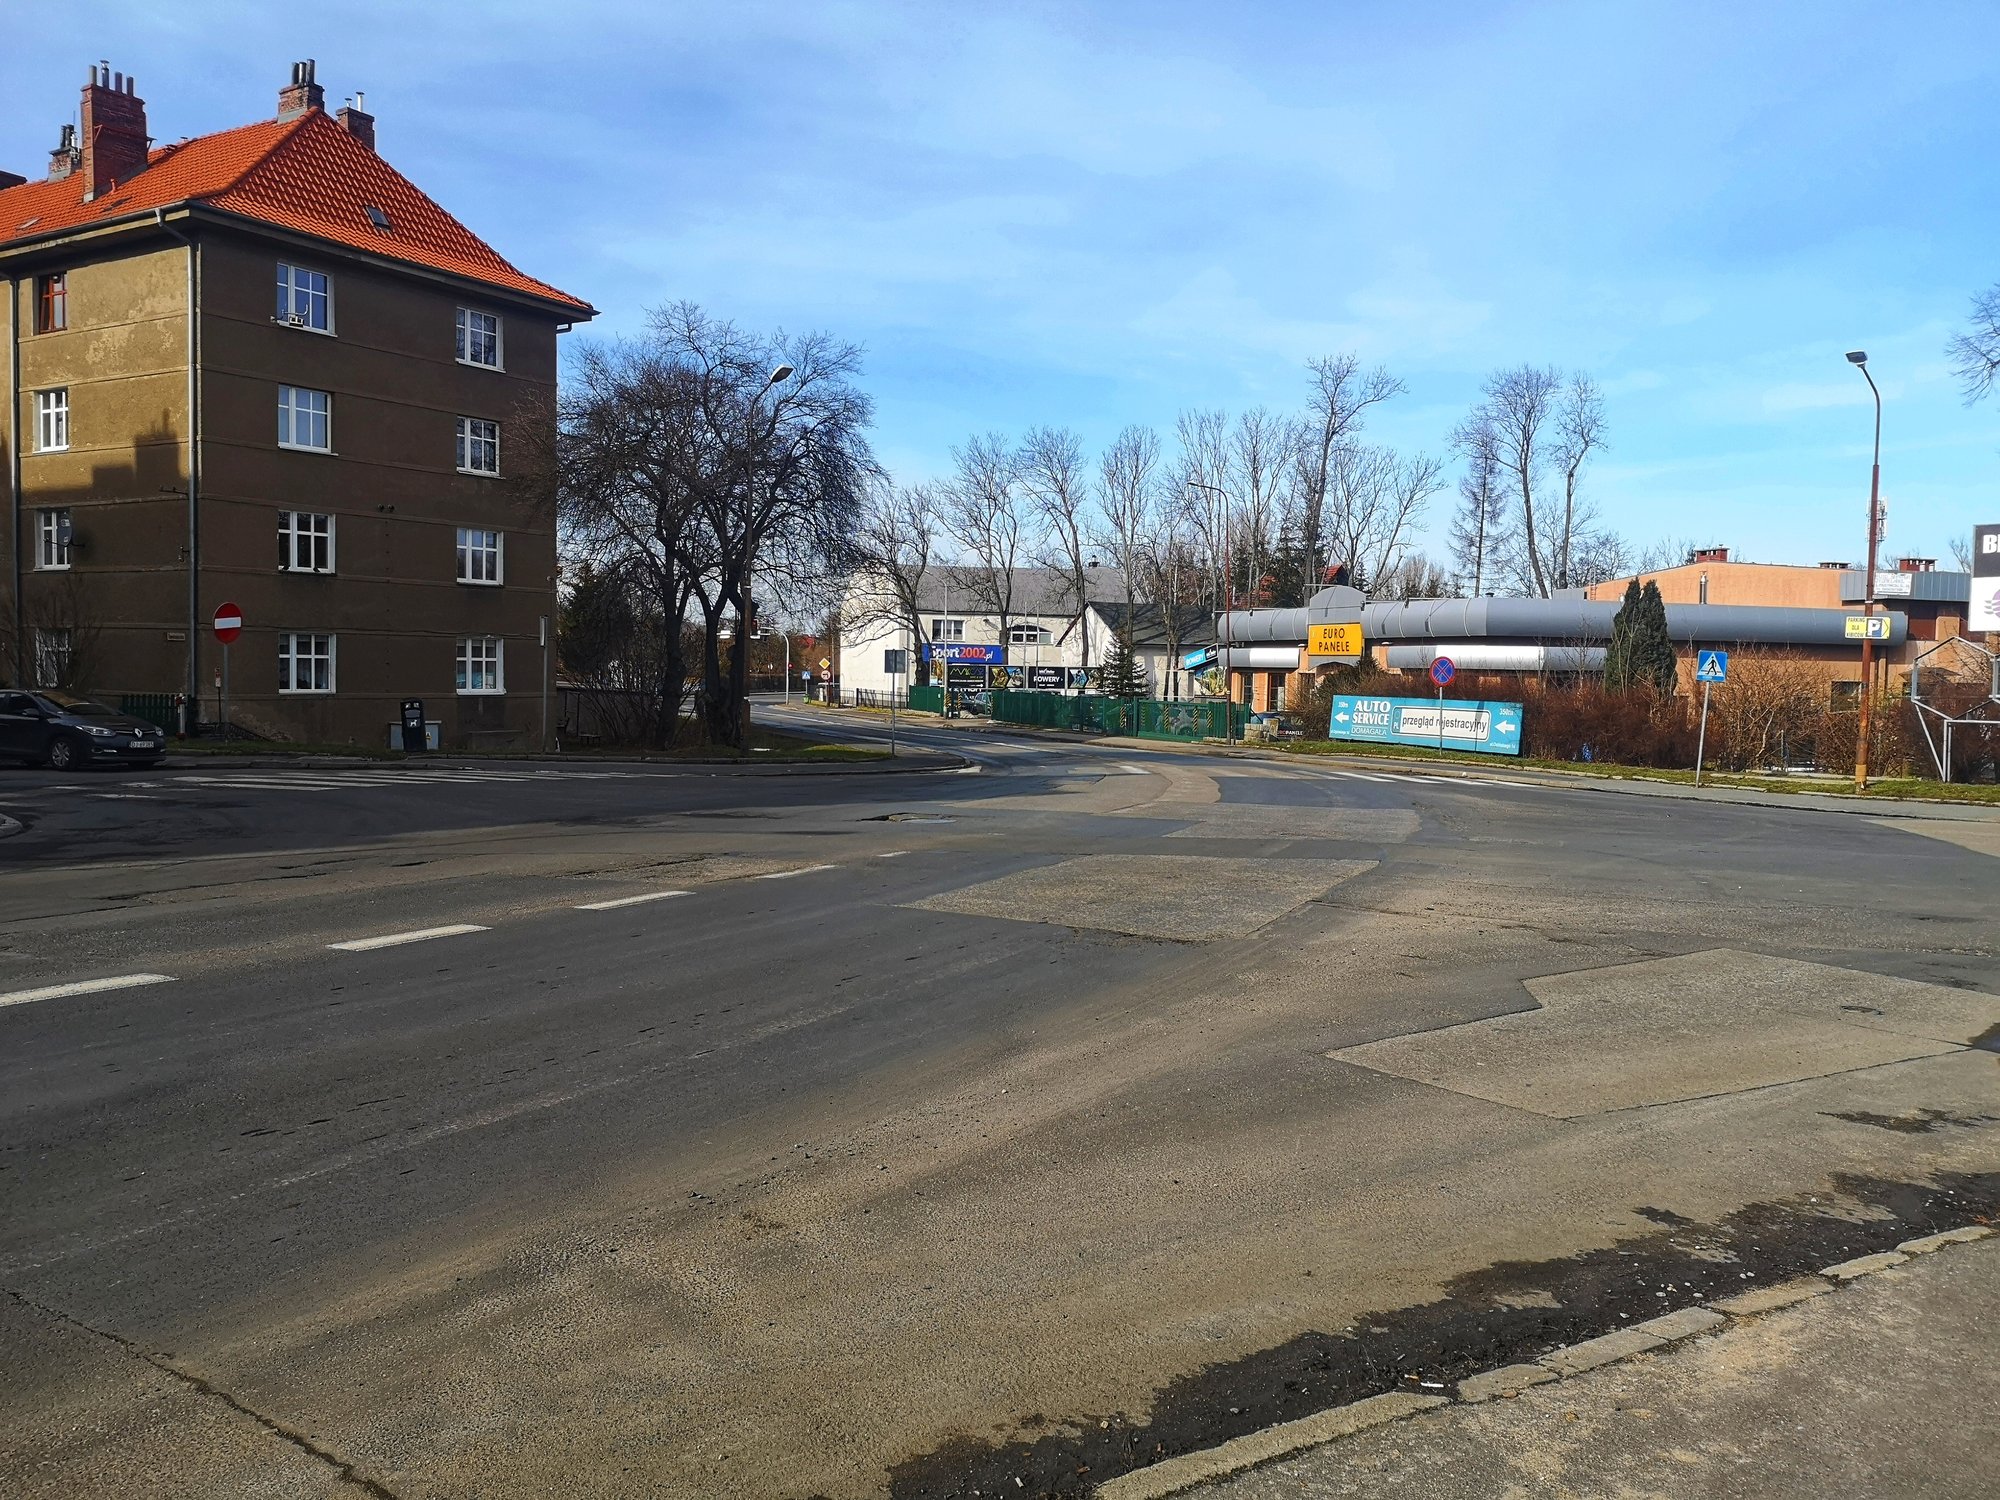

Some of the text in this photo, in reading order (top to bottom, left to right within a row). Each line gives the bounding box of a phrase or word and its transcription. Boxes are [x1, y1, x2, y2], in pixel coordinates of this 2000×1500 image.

[1323, 627, 1345, 639] EURO
[1318, 641, 1350, 652] PANELE
[1033, 675, 1060, 683] ROWERY
[1353, 700, 1391, 713] AUTO
[1352, 712, 1390, 725] SERVICE
[1402, 715, 1488, 733] przegląd rejestracyjny
